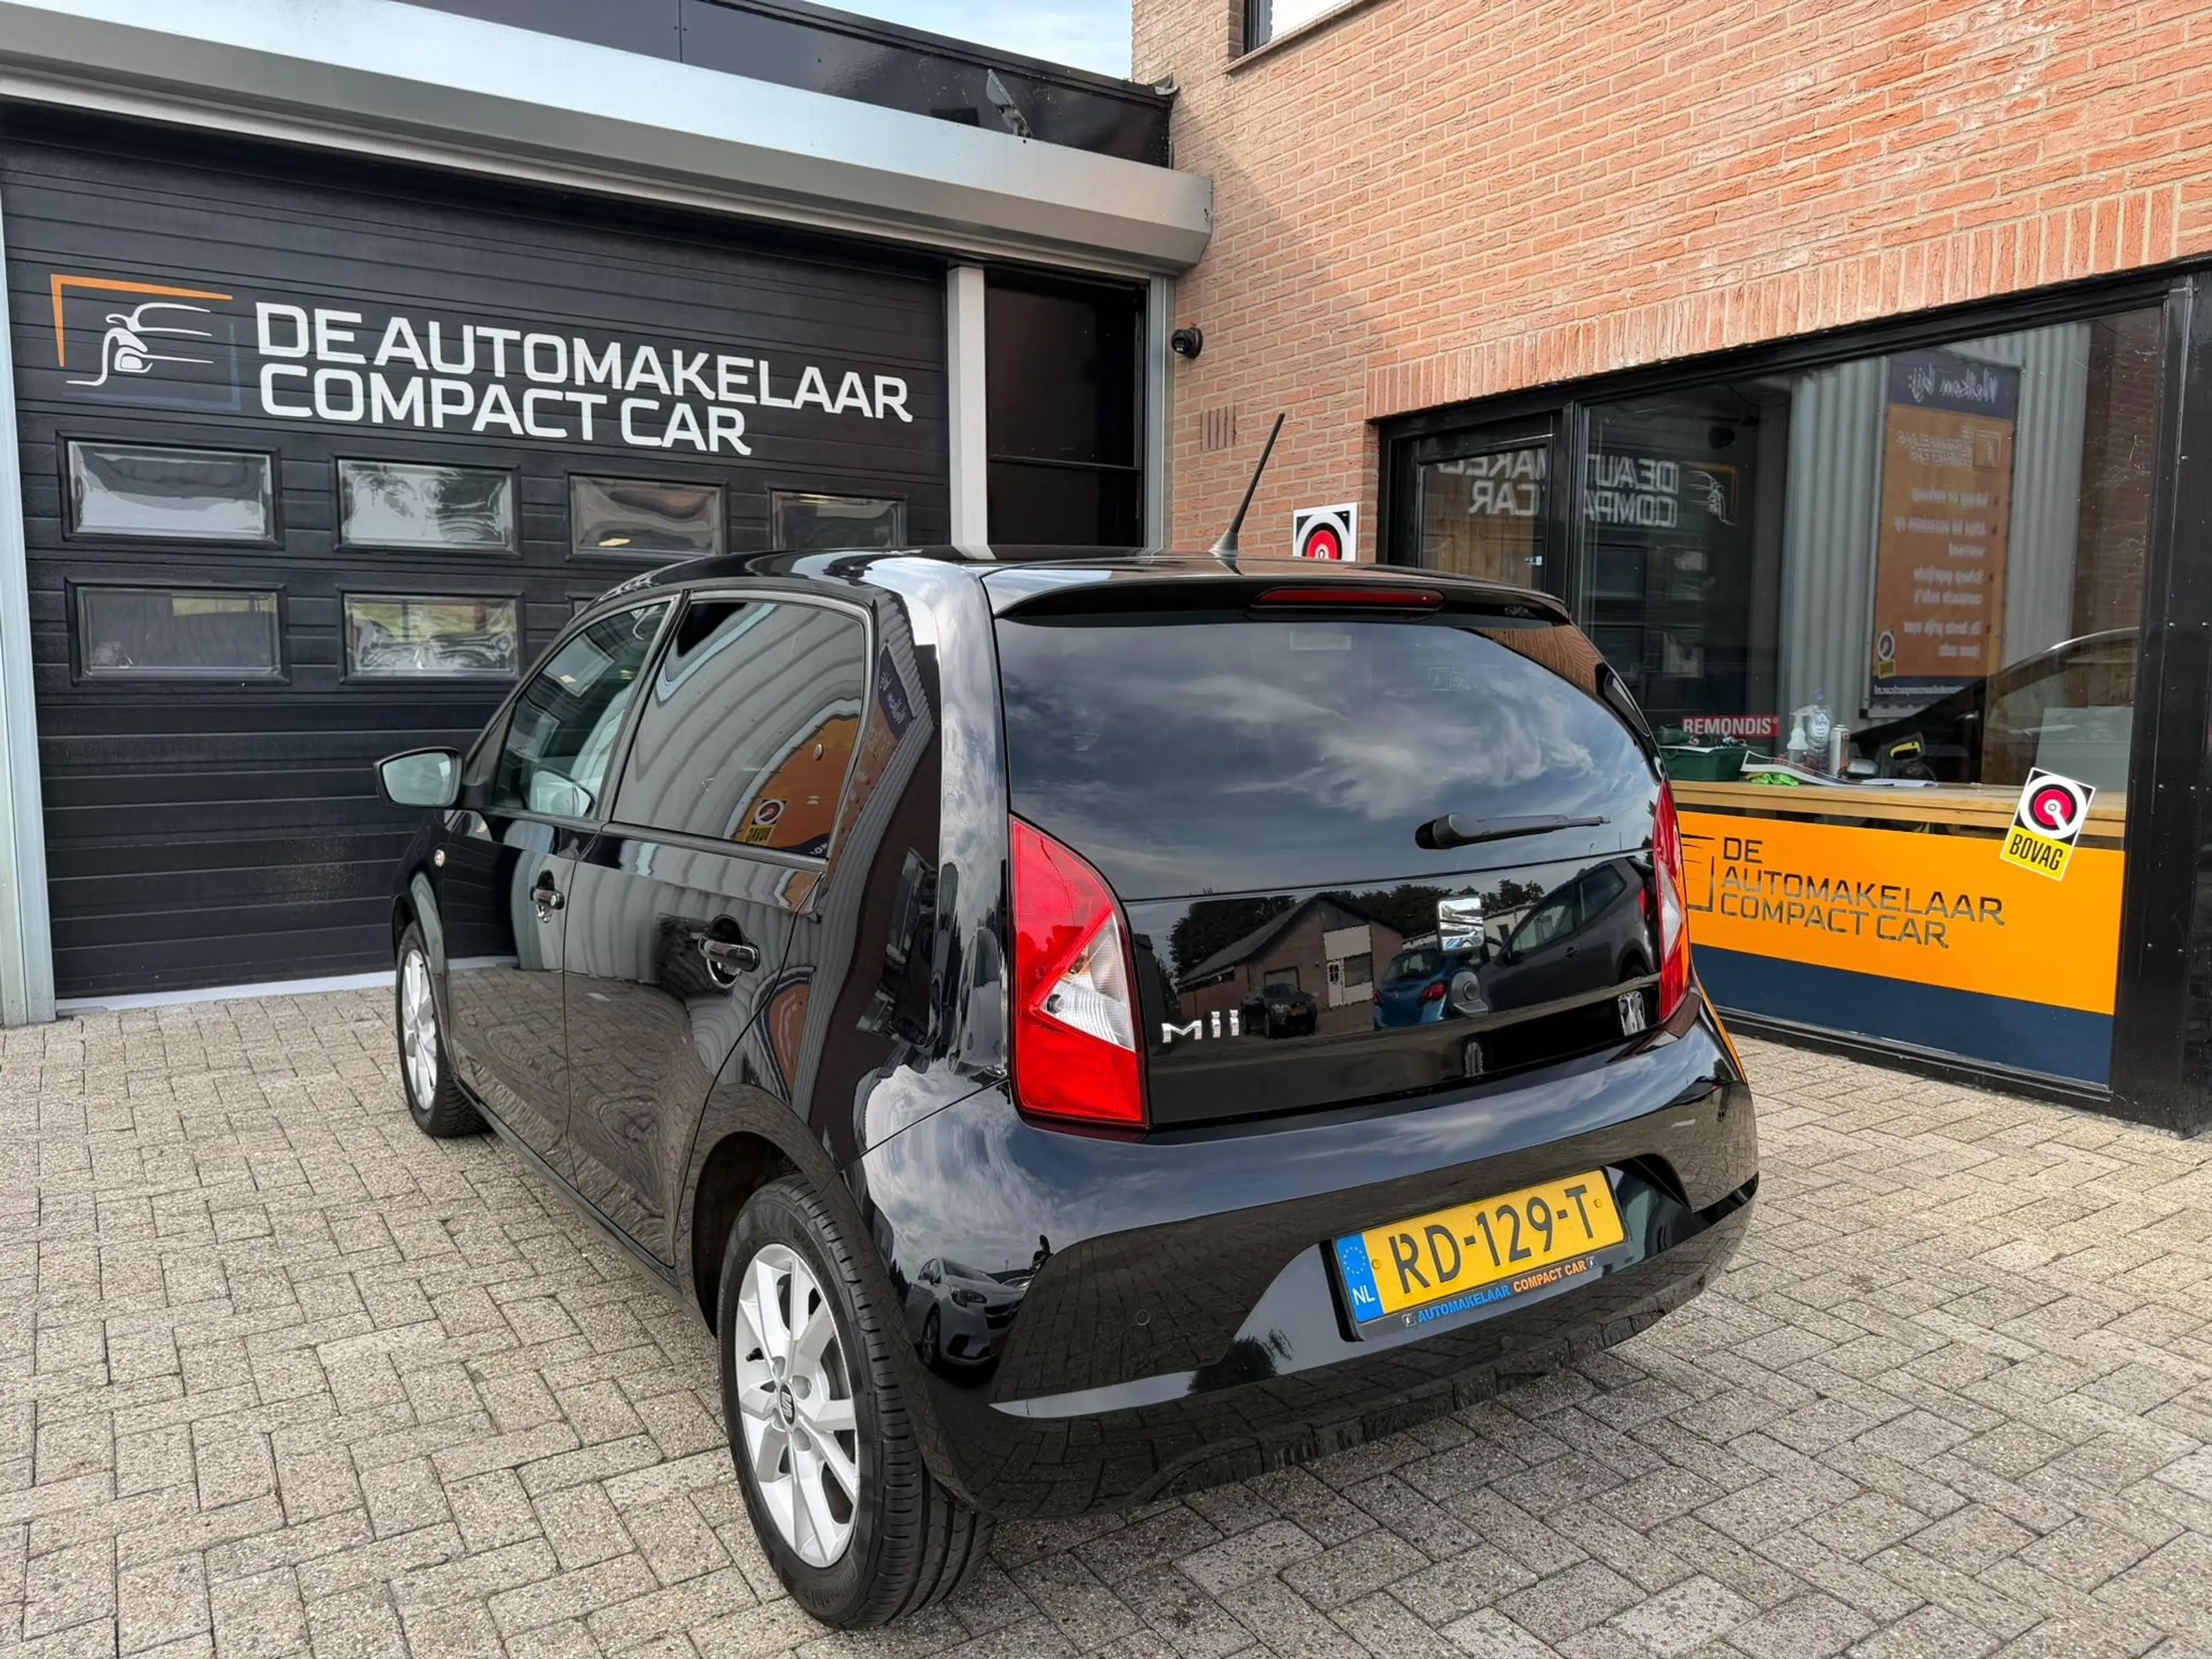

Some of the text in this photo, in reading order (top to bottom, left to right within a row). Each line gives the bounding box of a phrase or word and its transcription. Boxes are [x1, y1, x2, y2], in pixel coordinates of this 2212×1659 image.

[373, 316, 914, 423] AUTOMAKELAAR
[260, 362, 752, 456] COMPACT CAR
[1723, 836, 1763, 864] DE
[2009, 833, 2063, 871] BOVAG
[1719, 893, 1949, 949] COMPACT CAR
[1721, 866, 2005, 927] AUTOMAKELAAR
[1388, 1184, 1594, 1294] RD-129-T
[1352, 1284, 1376, 1306] NL
[1418, 1260, 1588, 1323] AUTOMAKELAAR COMPACT CAR
